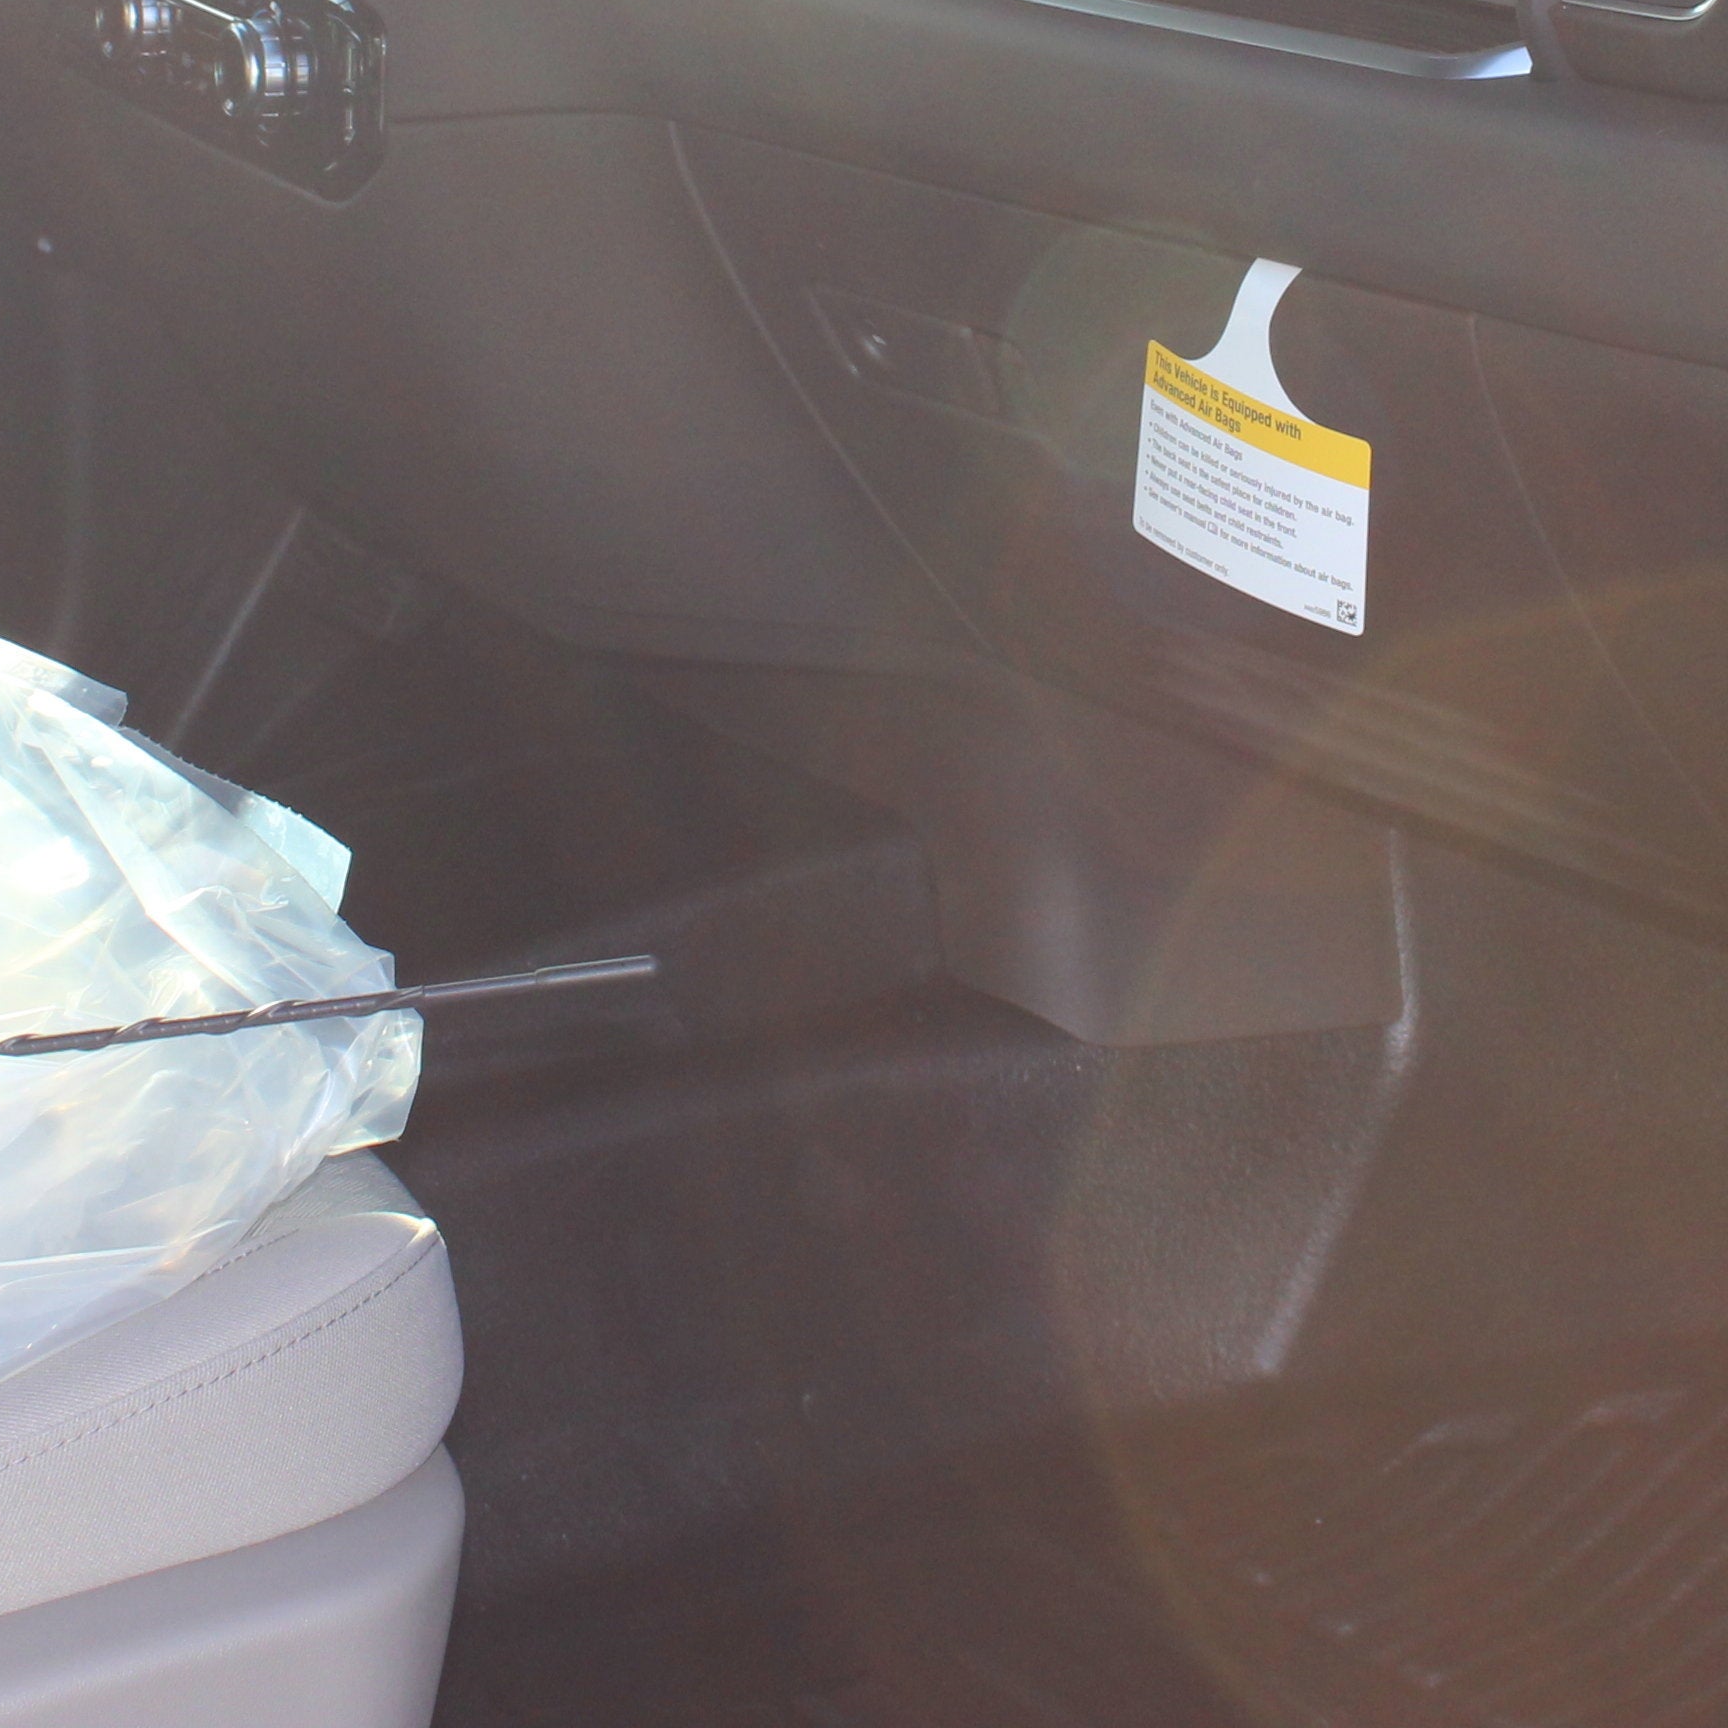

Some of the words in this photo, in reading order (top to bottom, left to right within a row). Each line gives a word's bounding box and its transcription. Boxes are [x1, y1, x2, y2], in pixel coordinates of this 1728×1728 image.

[1151, 399, 1164, 417] Even
[1165, 410, 1178, 425] with
[1179, 418, 1211, 445] Advanced
[1213, 437, 1223, 449] Air
[1224, 442, 1242, 461] Bags
[1153, 371, 1195, 408] Advanced
[1198, 399, 1213, 417] Air
[1215, 407, 1241, 433] Bags
[1155, 351, 1172, 374] This
[1174, 363, 1208, 395] Vehicle
[1210, 384, 1219, 402] is
[1222, 391, 1272, 427] Equipped
[1275, 419, 1301, 440] with
[1150, 471, 1169, 491] Always
[1170, 485, 1181, 498] use
[1182, 492, 1195, 506] seat
[1196, 498, 1212, 515] belts
[1214, 510, 1227, 523] and
[1228, 516, 1245, 532] child
[1151, 455, 1166, 472] Never
[1167, 467, 1178, 479] put
[1183, 477, 1219, 504] rear-facing
[1220, 495, 1236, 511] child
[1238, 503, 1252, 519] seat
[1255, 512, 1261, 522] in
[1263, 516, 1275, 529] the
[1152, 437, 1162, 451] The
[1163, 446, 1176, 461] back
[1178, 456, 1191, 471] seat
[1199, 467, 1209, 480] the
[1211, 474, 1231, 492] safest
[1232, 485, 1251, 501] place
[1253, 494, 1263, 506] for
[1154, 423, 1177, 445] Children
[1178, 440, 1190, 452] can
[1191, 446, 1199, 458] be
[1201, 451, 1219, 469] killed
[1220, 463, 1228, 473] or
[1229, 468, 1262, 491] seriously
[1264, 482, 1291, 503] injured
[1293, 495, 1303, 508] by
[1305, 500, 1319, 513] the
[1321, 506, 1333, 517] air
[1335, 510, 1354, 526] bag.
[1183, 510, 1207, 529] manual
[1219, 528, 1229, 540] for
[1231, 535, 1248, 550] more
[1250, 542, 1292, 569] information
[1294, 562, 1316, 578] about
[1318, 571, 1329, 582] air
